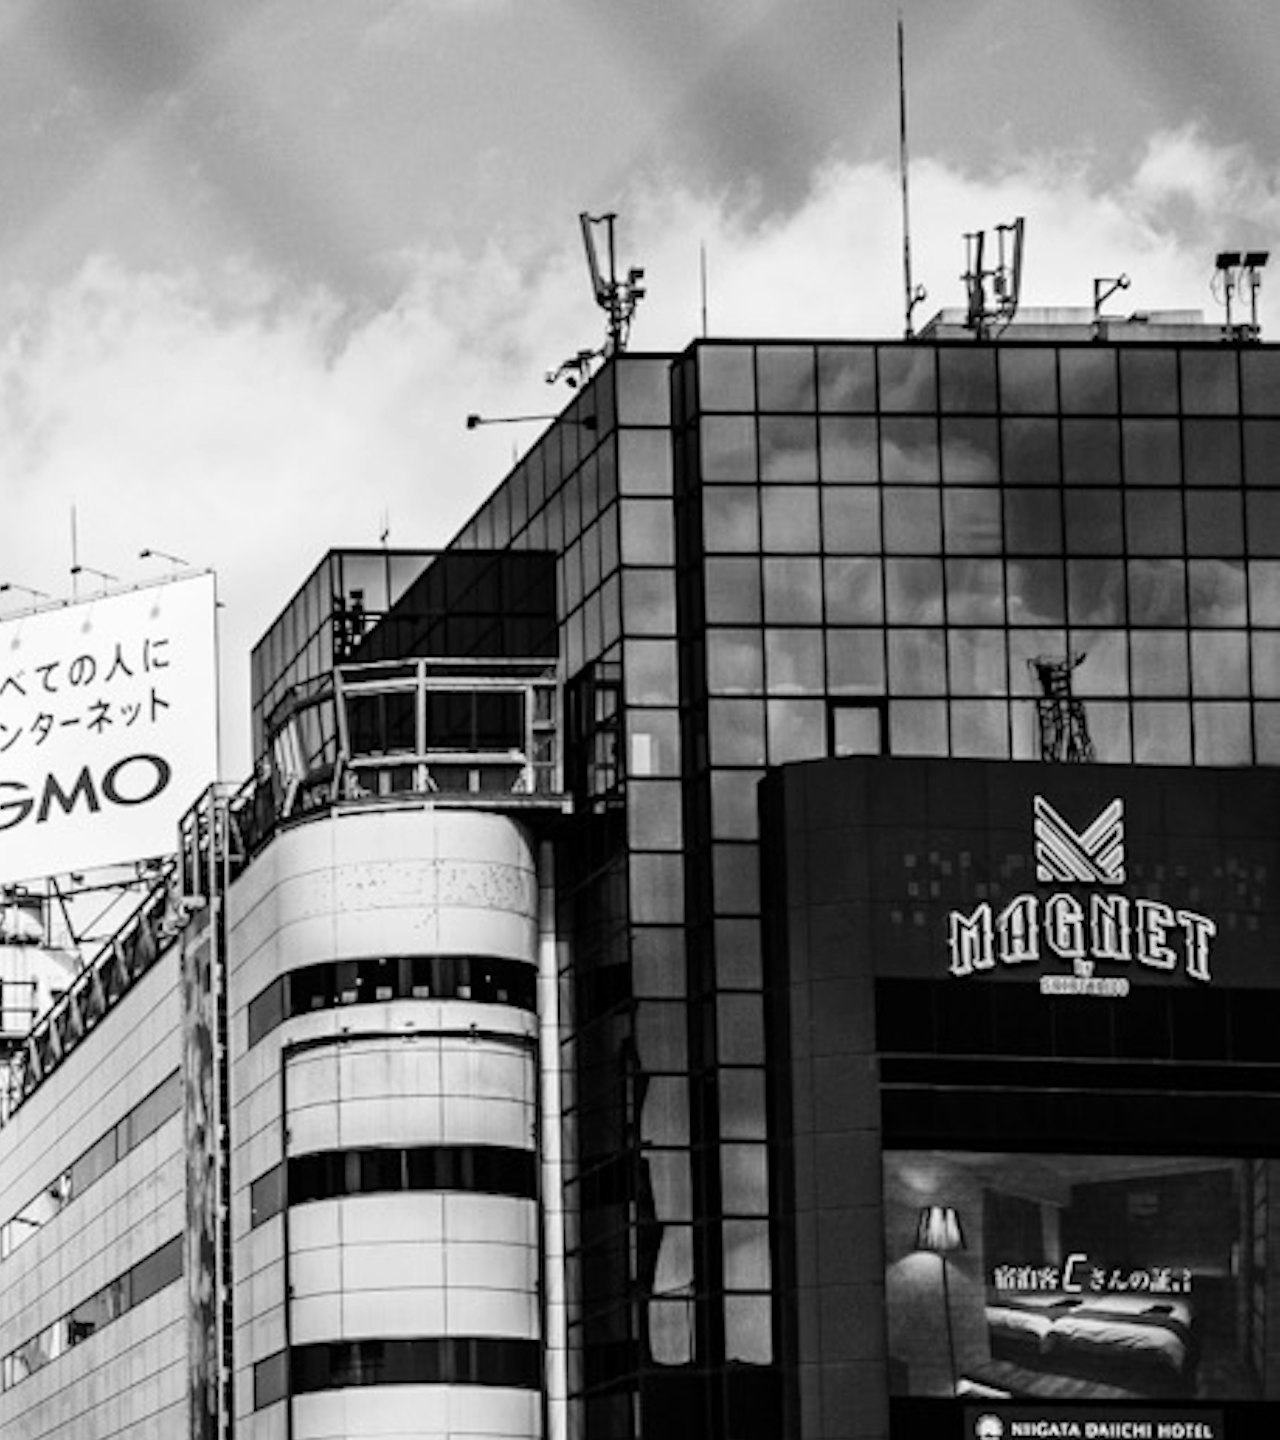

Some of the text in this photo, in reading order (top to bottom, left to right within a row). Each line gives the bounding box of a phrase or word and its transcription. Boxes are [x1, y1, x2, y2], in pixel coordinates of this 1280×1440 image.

[947, 892, 1217, 982] MAGNET
[1011, 1421, 1214, 1440] NIIGATA DAIICHI HOTEL
